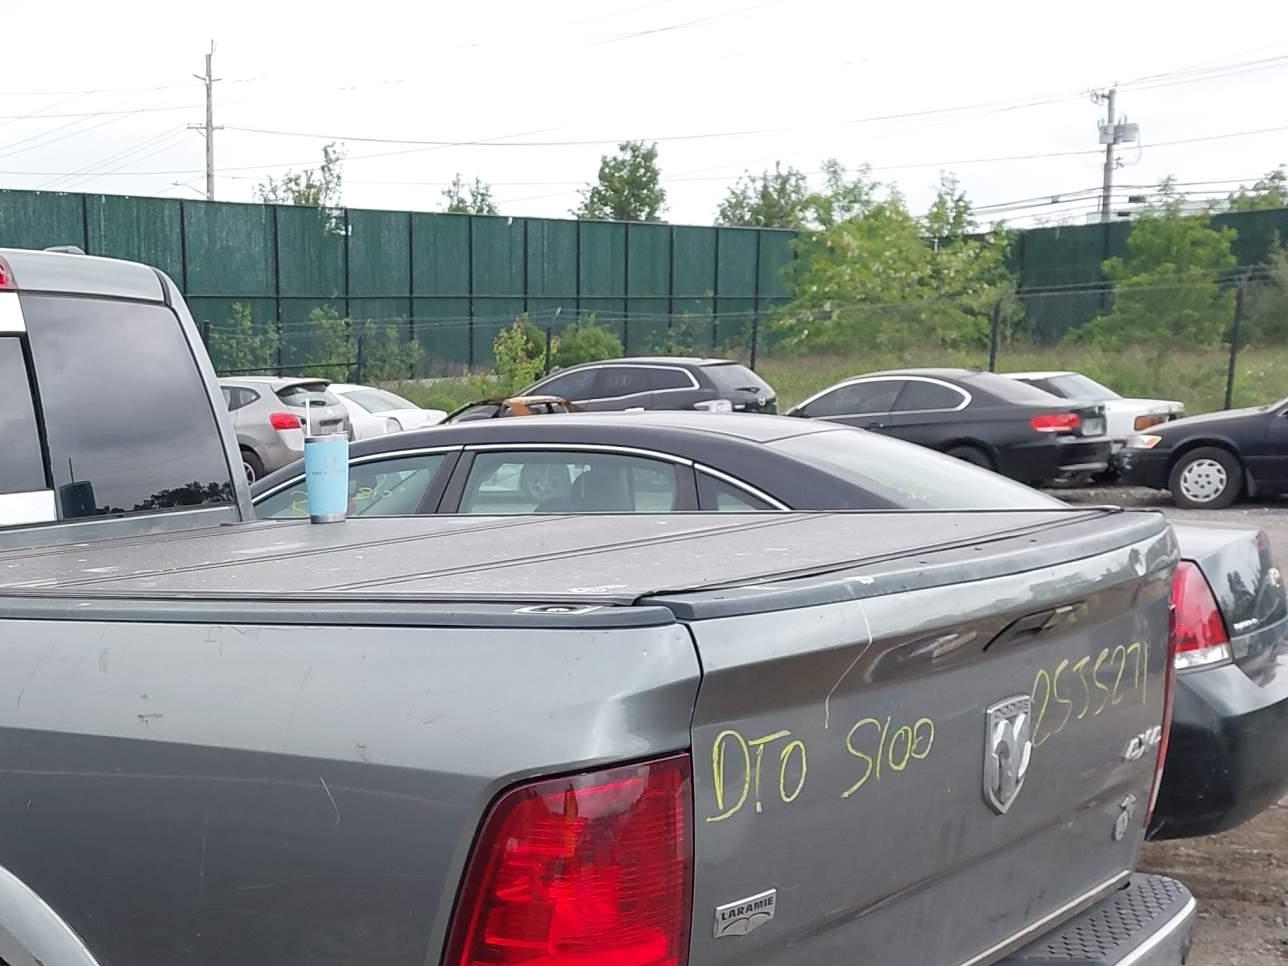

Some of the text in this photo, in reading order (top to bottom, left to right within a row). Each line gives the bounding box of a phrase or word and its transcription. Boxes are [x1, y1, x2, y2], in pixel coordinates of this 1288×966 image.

[992, 699, 1031, 720] DODGE
[706, 729, 808, 823] DTO
[720, 895, 775, 922] LARAMIE
